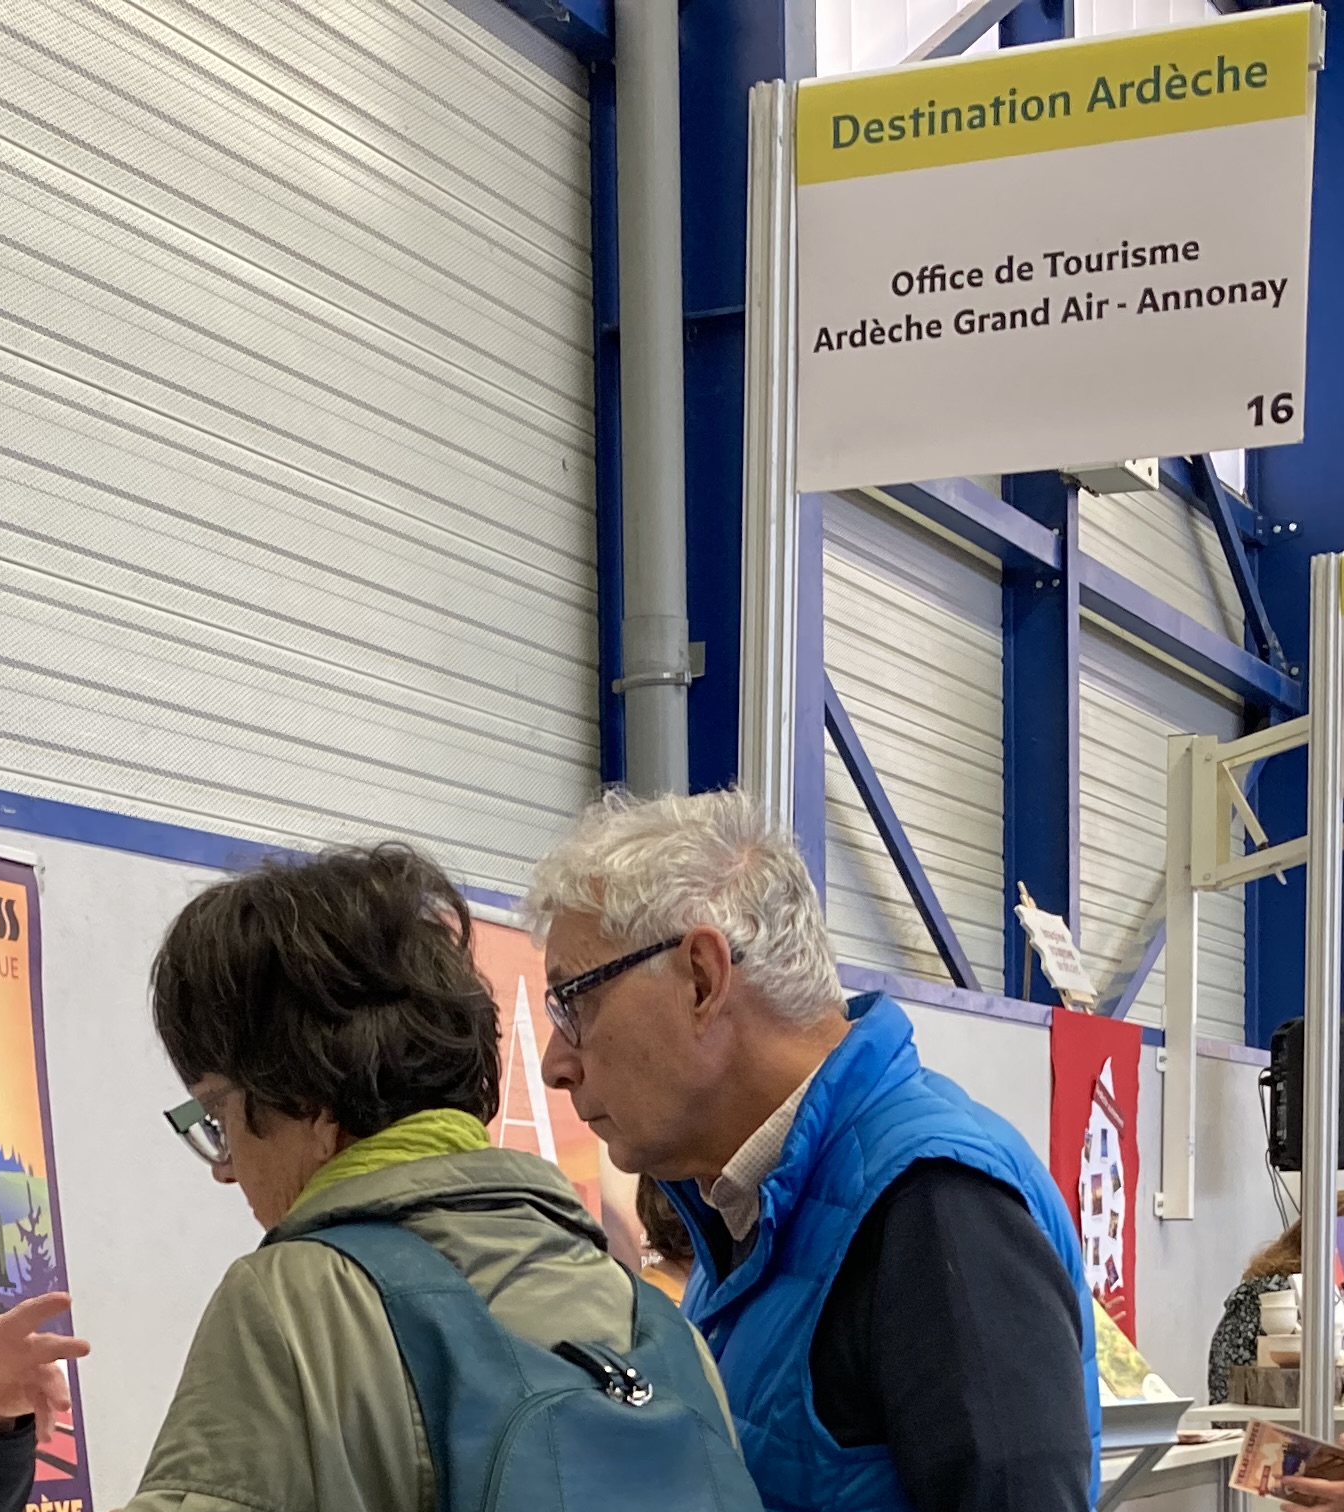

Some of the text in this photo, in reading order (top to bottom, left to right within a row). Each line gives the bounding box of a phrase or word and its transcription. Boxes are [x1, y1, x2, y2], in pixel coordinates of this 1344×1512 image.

[831, 55, 1268, 149] Destination Ardèche
[891, 238, 1200, 297] Office de Tourisme
[813, 316, 943, 353] Ardèche
[953, 299, 1050, 336] Grand
[1061, 293, 1109, 325] Air
[1136, 276, 1289, 316] Annonay
[1246, 393, 1294, 428] 16
